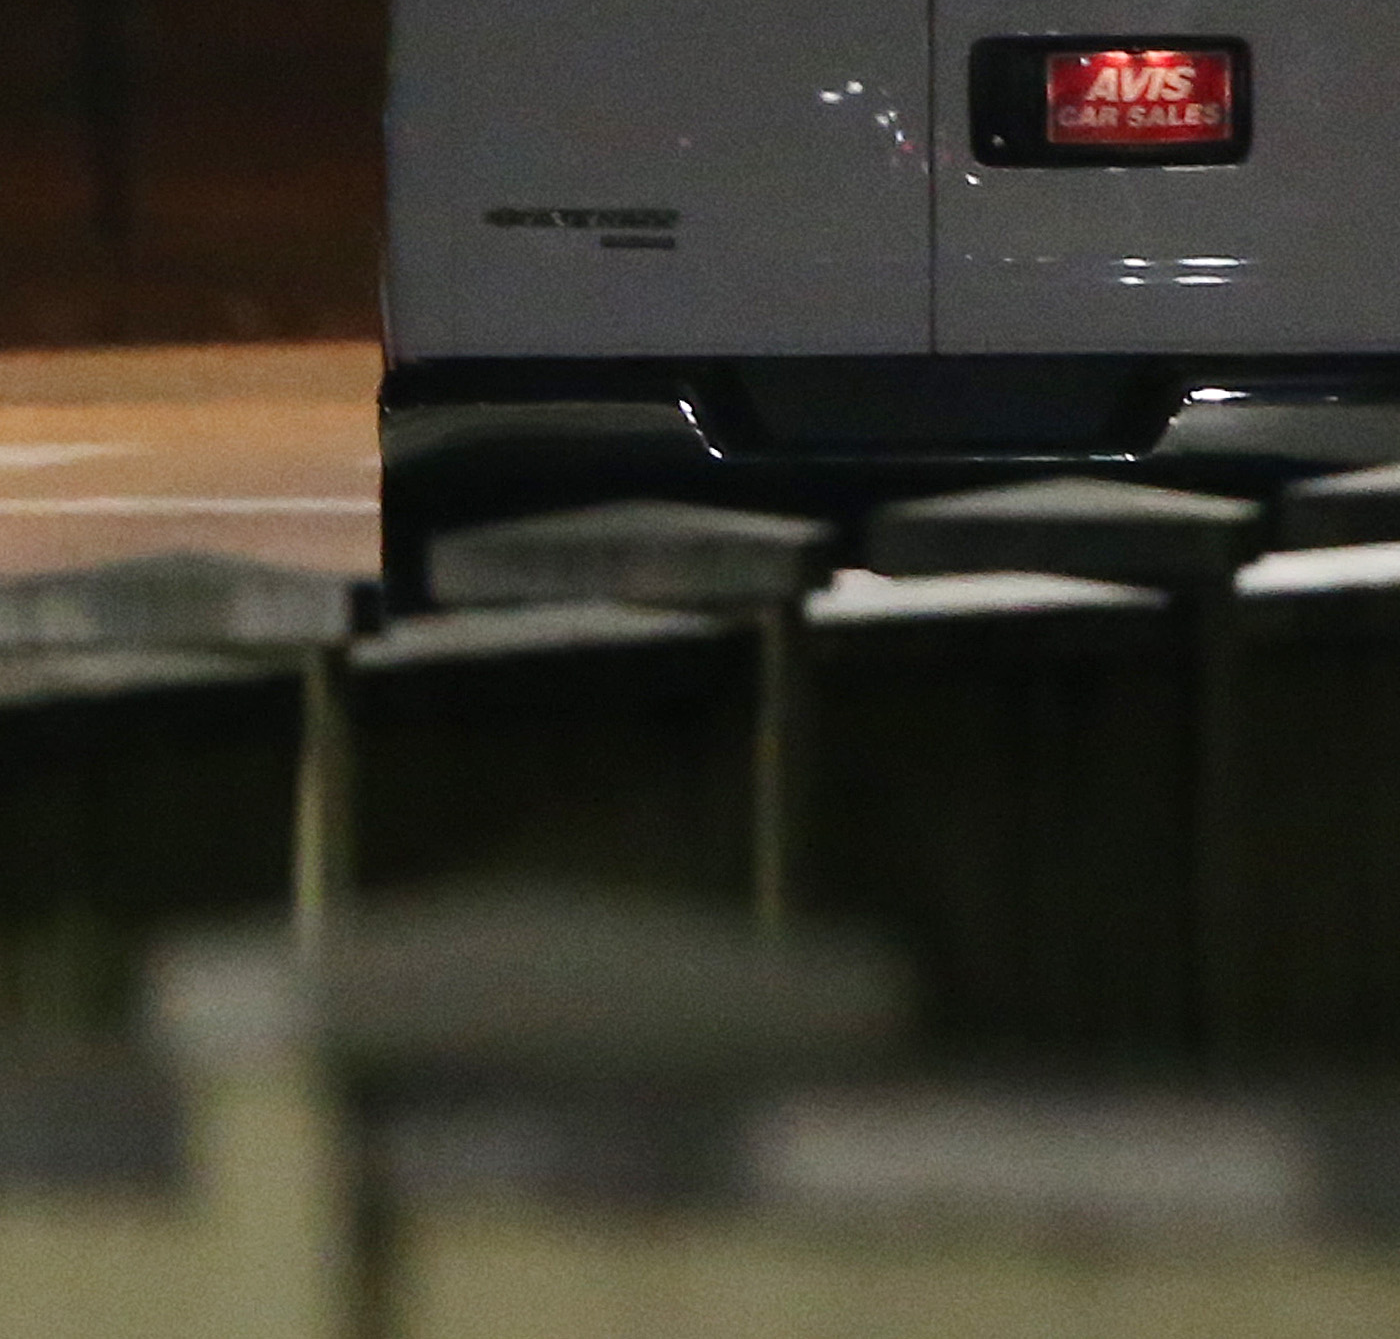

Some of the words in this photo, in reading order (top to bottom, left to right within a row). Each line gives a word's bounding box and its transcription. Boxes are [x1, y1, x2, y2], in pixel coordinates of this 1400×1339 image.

[1085, 65, 1197, 103] AVIS
[1056, 105, 1119, 129] CAR
[1127, 102, 1221, 128] SALES
